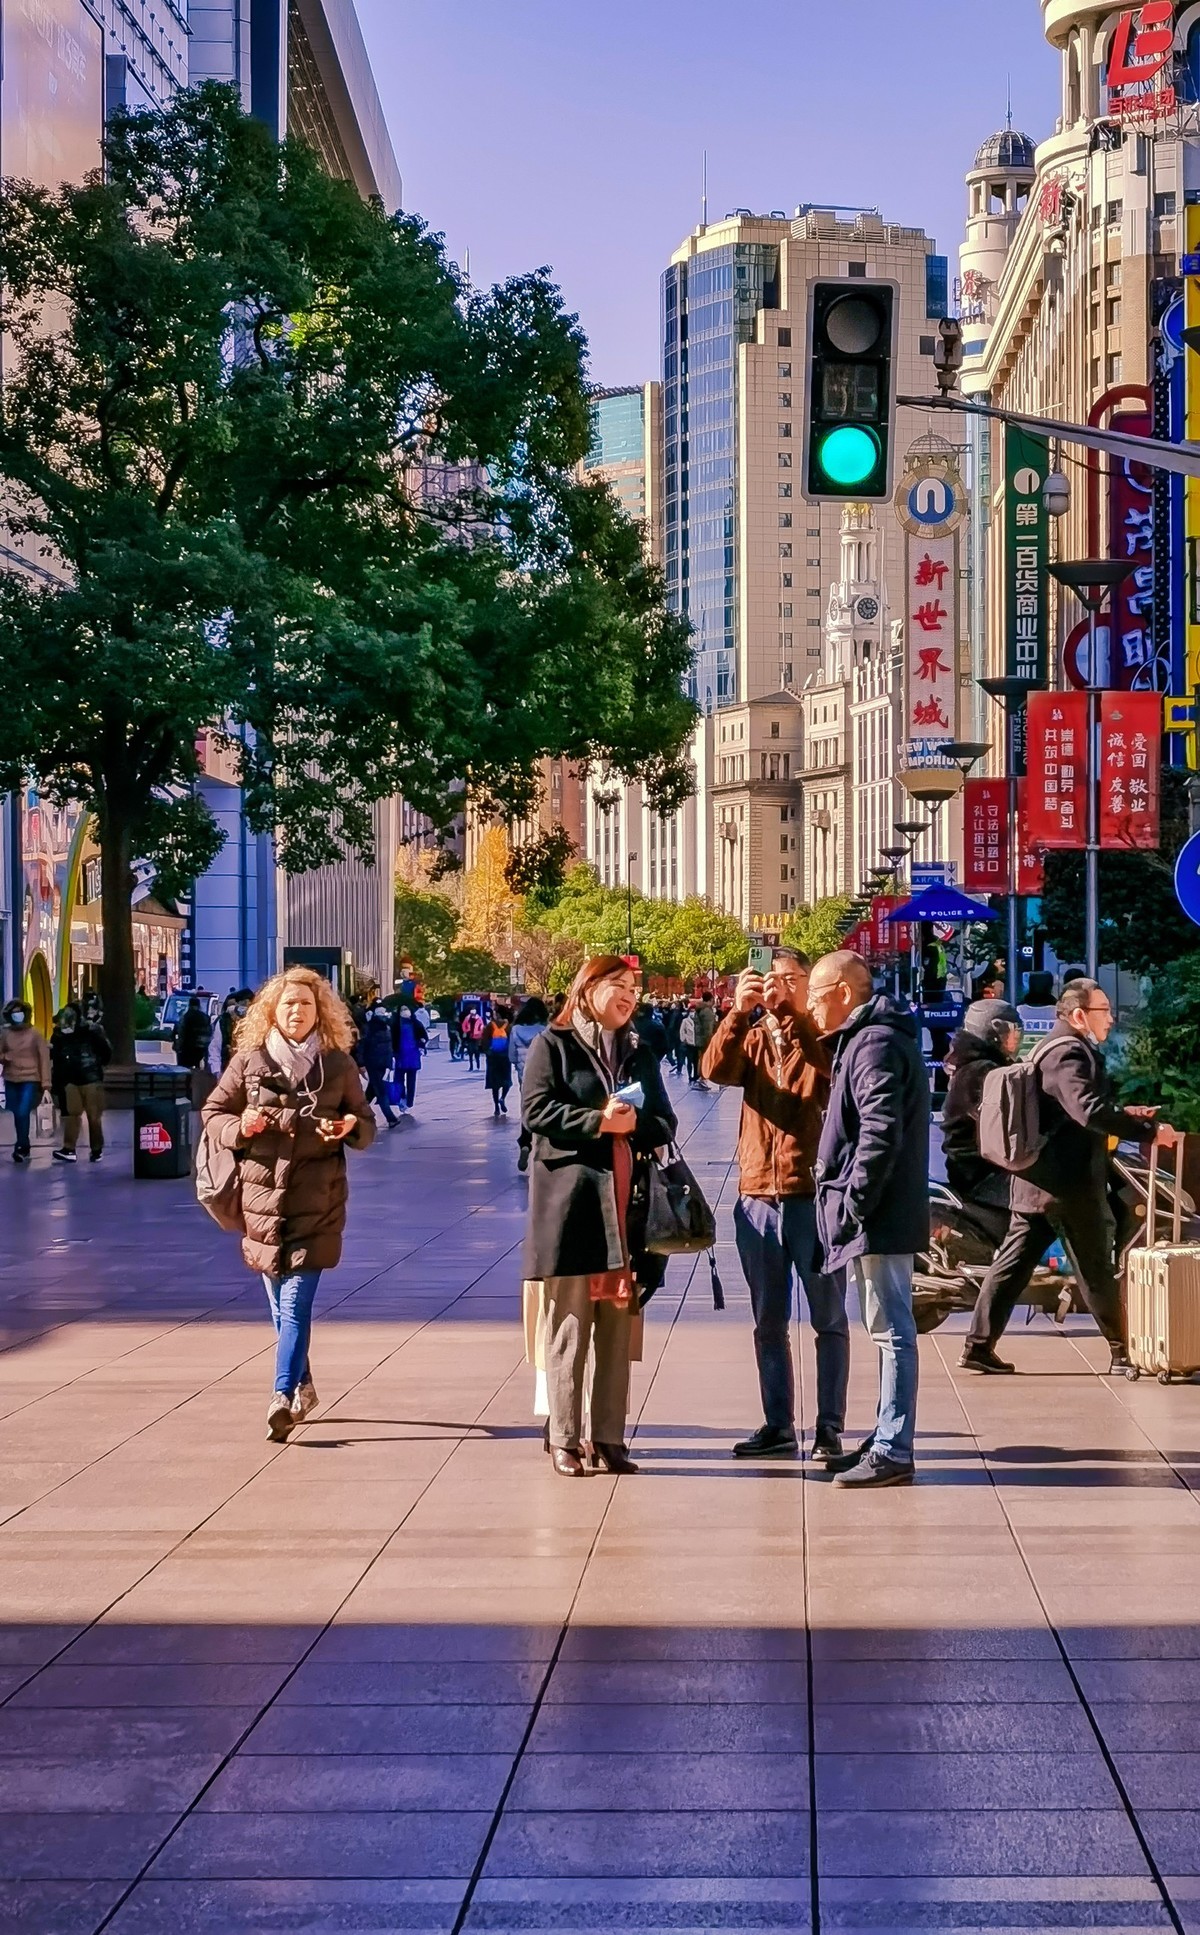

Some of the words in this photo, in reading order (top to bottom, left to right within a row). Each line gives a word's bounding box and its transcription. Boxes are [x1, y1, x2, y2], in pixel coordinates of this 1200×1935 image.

[912, 552, 951, 729] 新世界城
[1106, 732, 1127, 768] 诚信
[1131, 732, 1147, 768] 爱国
[1108, 776, 1126, 814] 友善
[1128, 778, 1149, 813] 敬业
[930, 1010, 951, 1018] POLICE
